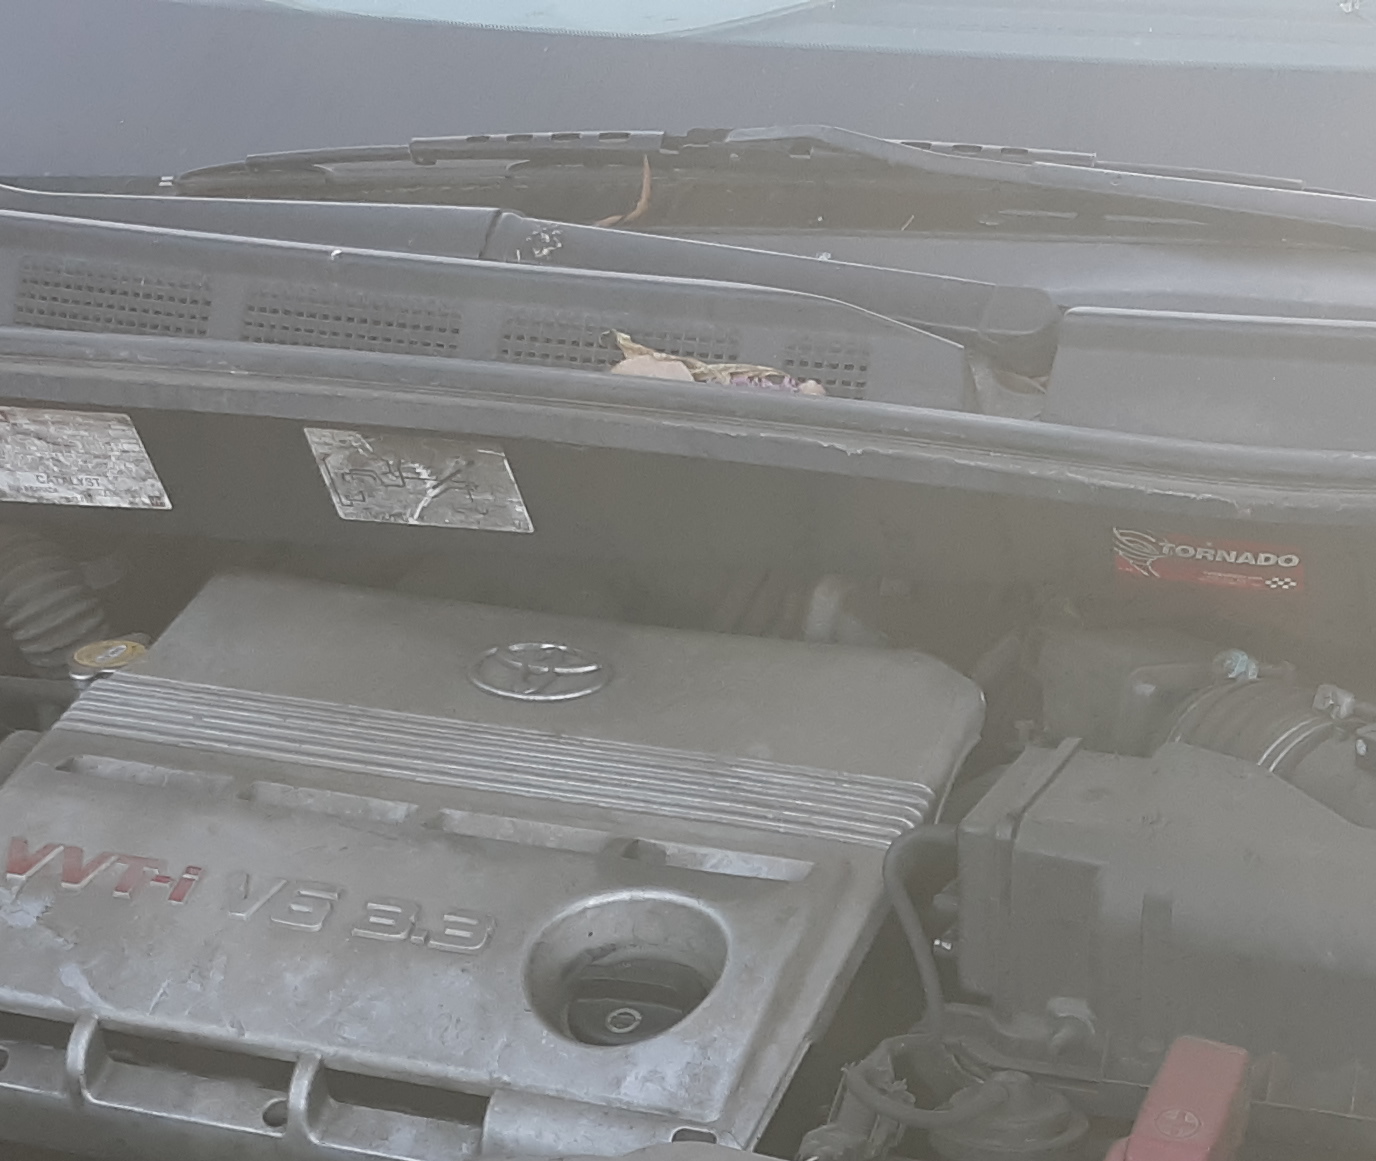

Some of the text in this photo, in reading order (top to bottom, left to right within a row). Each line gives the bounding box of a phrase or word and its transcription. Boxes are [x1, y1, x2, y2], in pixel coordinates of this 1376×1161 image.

[35, 473, 101, 488] CATALYST
[1160, 541, 1301, 568] TORNADO
[225, 869, 343, 933] V6
[351, 898, 496, 955] 3.3
